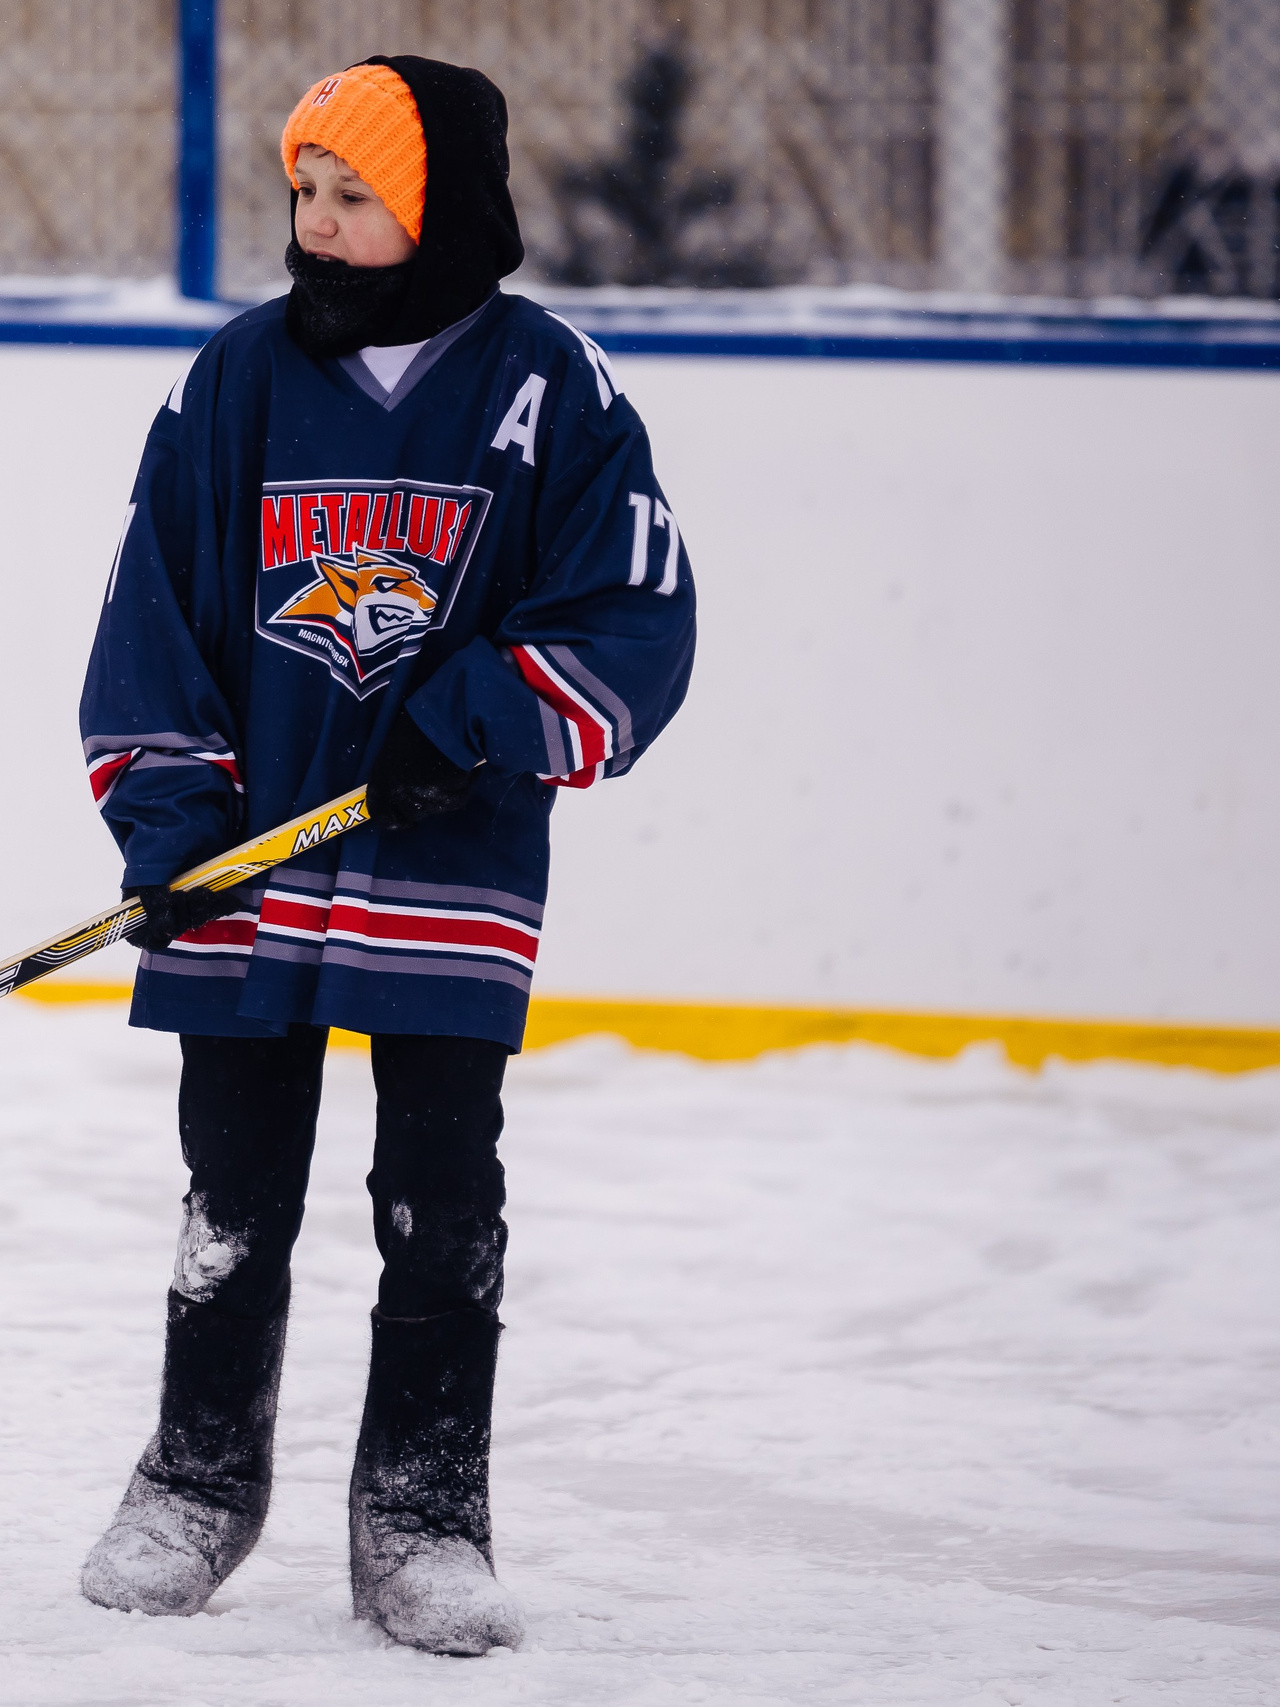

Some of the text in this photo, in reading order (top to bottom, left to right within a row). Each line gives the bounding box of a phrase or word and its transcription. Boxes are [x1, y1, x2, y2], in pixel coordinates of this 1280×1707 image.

[490, 373, 548, 467] A
[261, 491, 472, 572] METALLUR
[628, 491, 681, 597] 17
[289, 798, 368, 857] MAX
